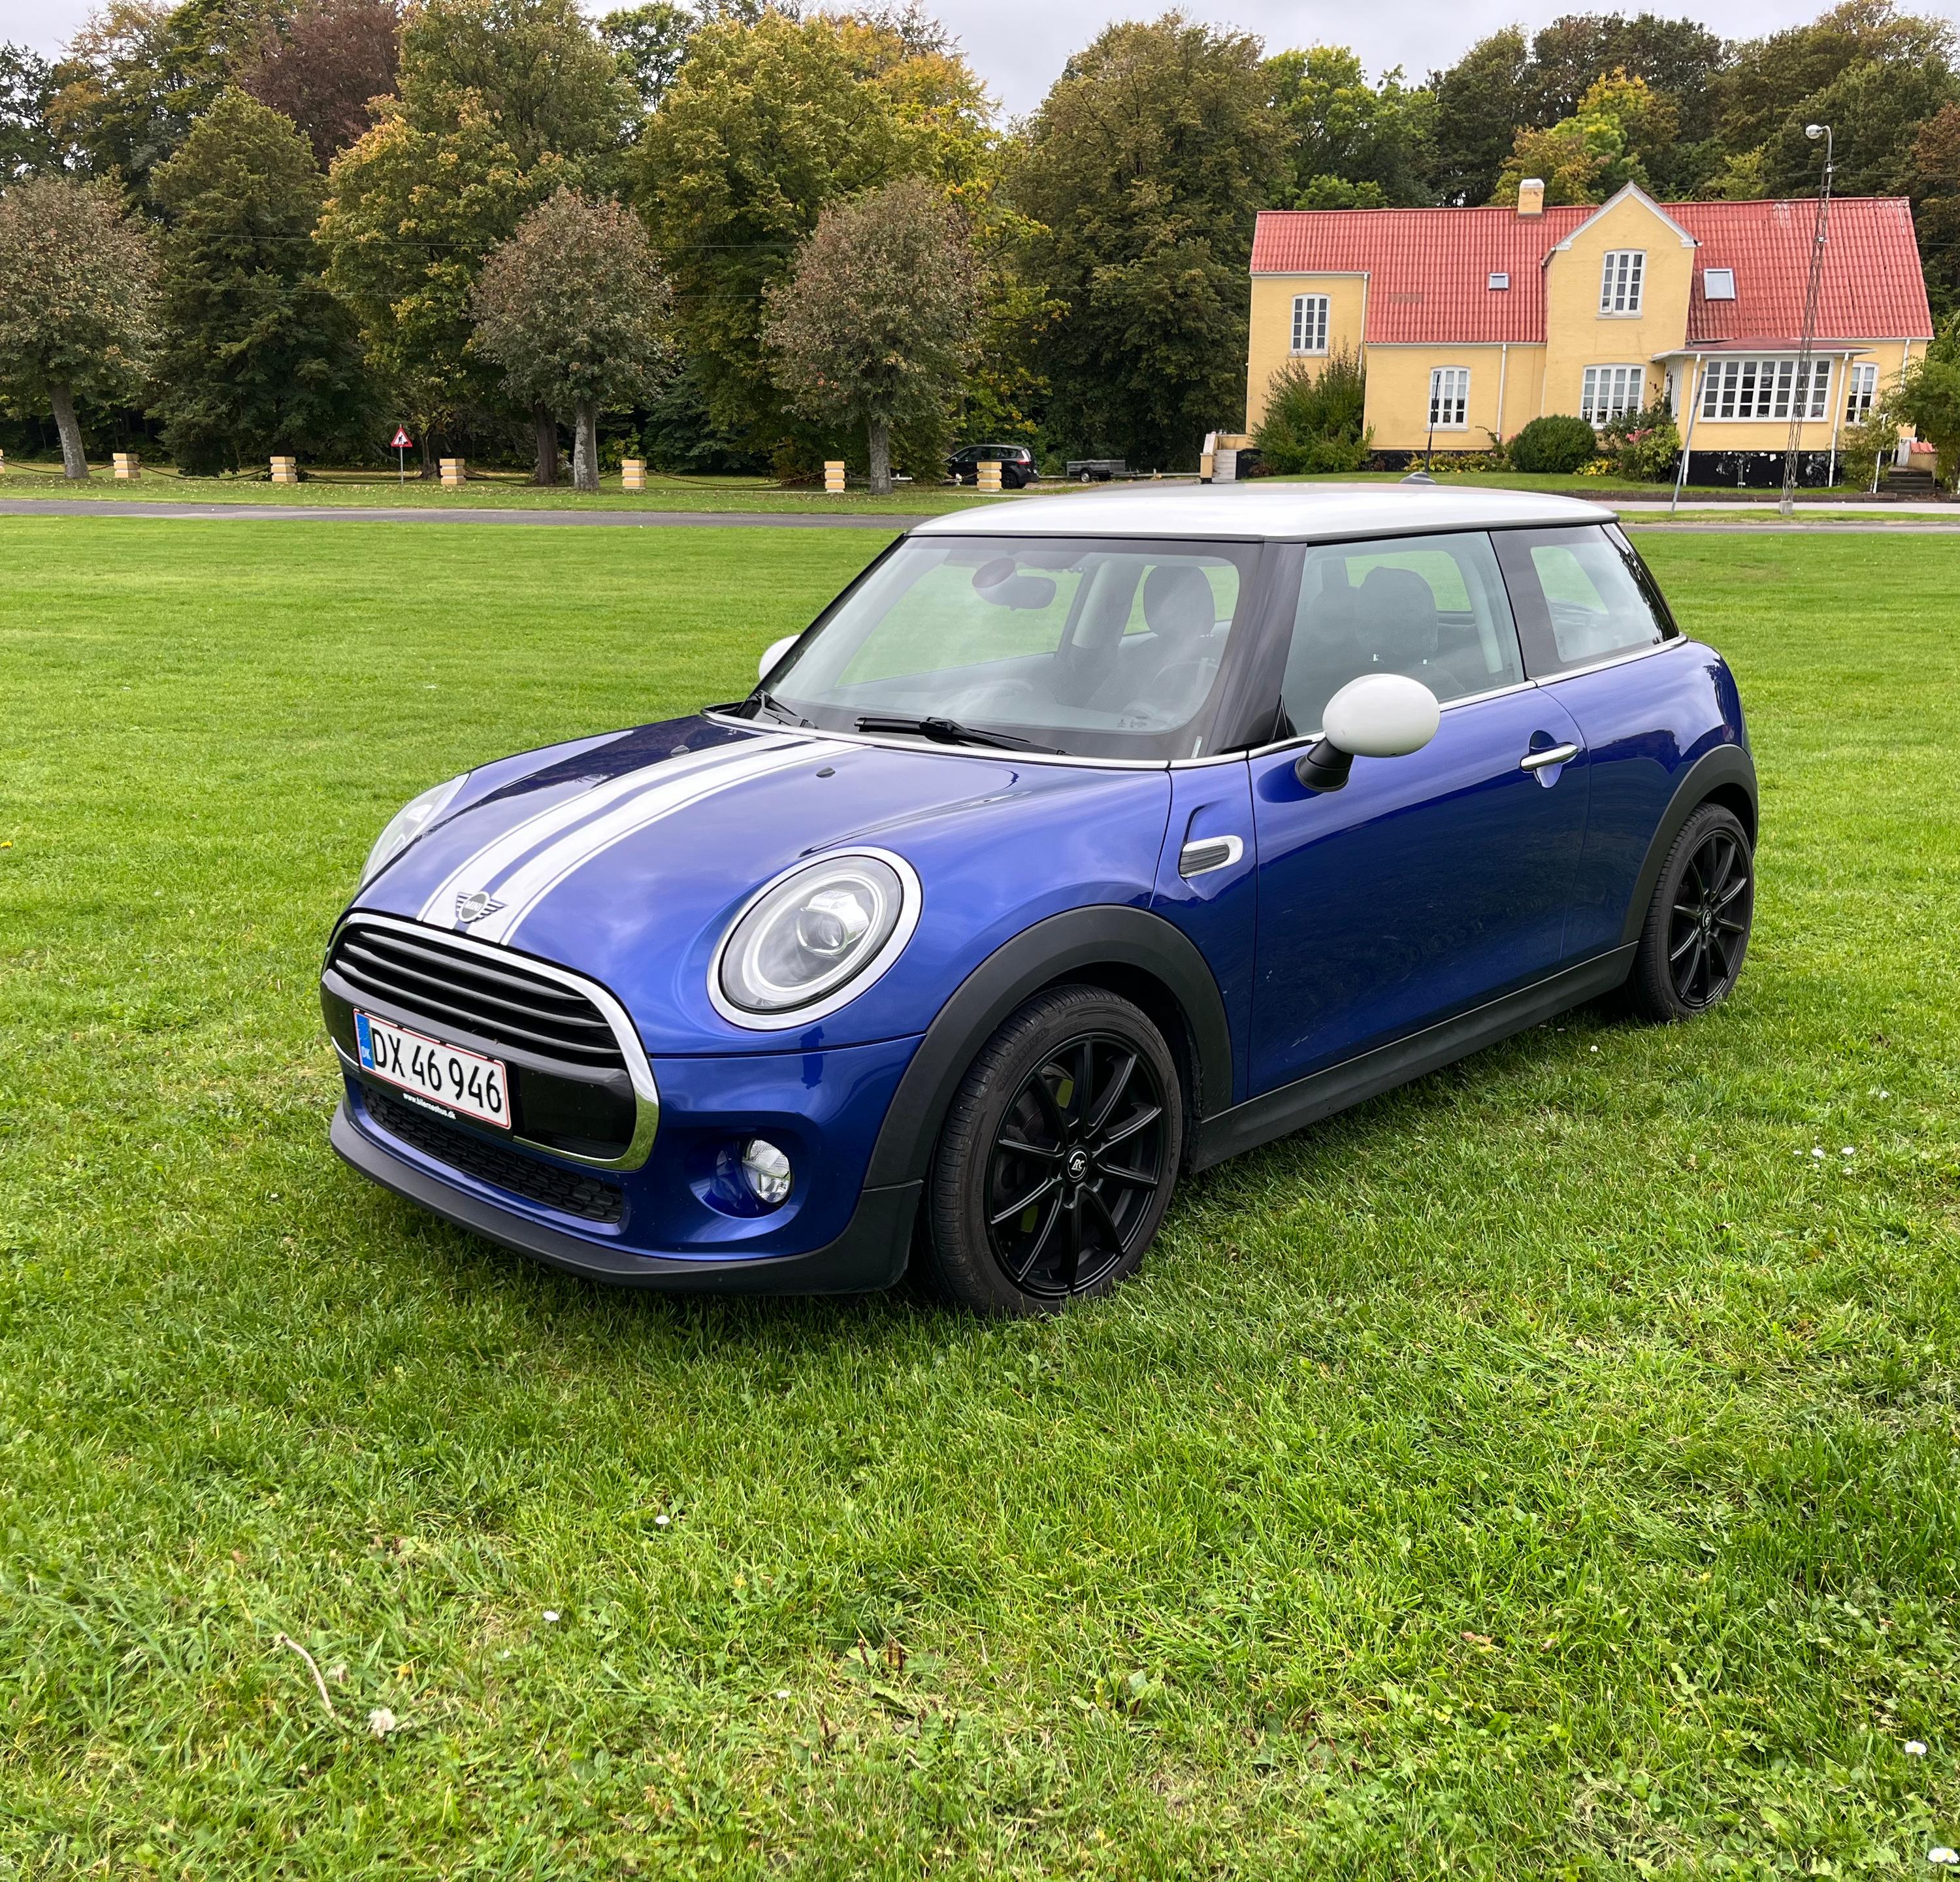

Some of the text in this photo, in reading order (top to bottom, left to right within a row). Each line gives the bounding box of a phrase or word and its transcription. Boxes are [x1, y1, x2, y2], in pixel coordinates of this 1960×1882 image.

[464, 900, 483, 912] MINI
[361, 1046, 372, 1060] DK
[372, 1027, 501, 1113] DX 46 946
